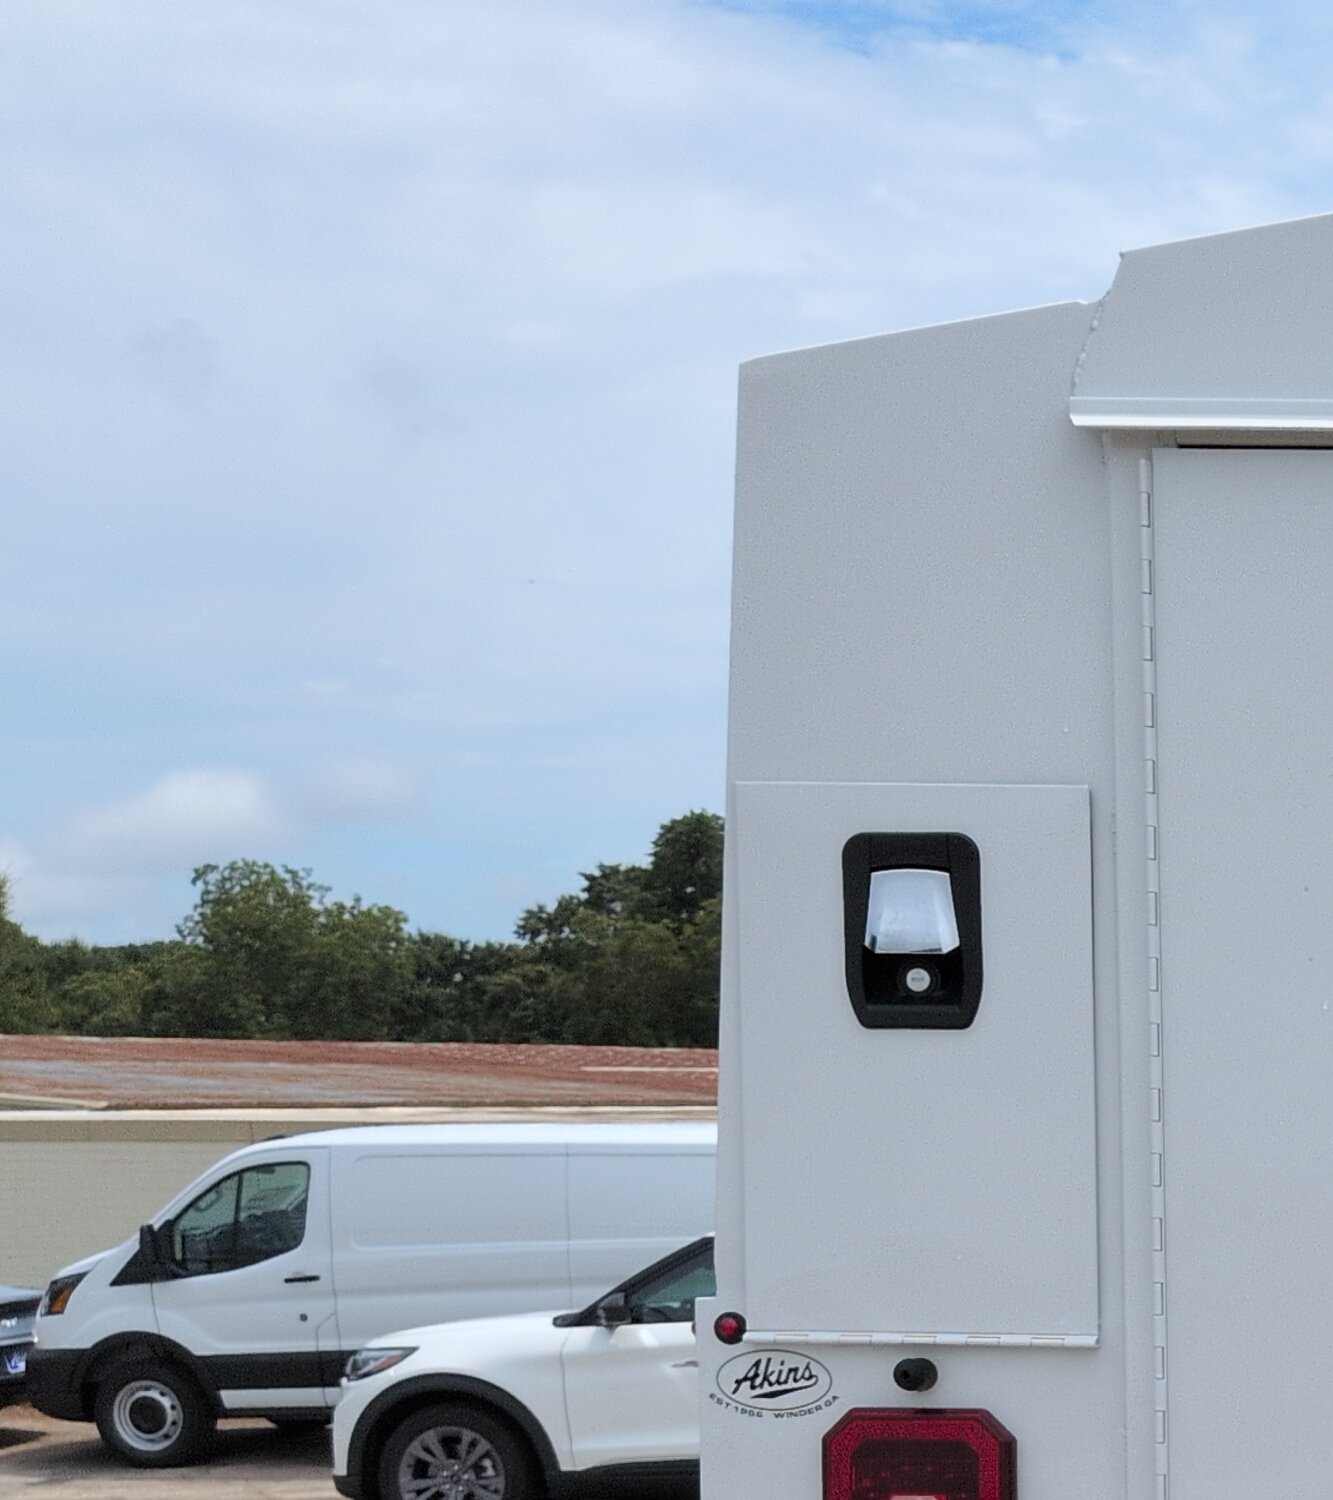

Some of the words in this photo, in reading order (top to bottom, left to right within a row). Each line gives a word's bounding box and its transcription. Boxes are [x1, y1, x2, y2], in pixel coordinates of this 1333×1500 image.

[732, 1357, 818, 1398] Akins
[773, 1404, 823, 1419] WINDER
[823, 1394, 840, 1408] GA
